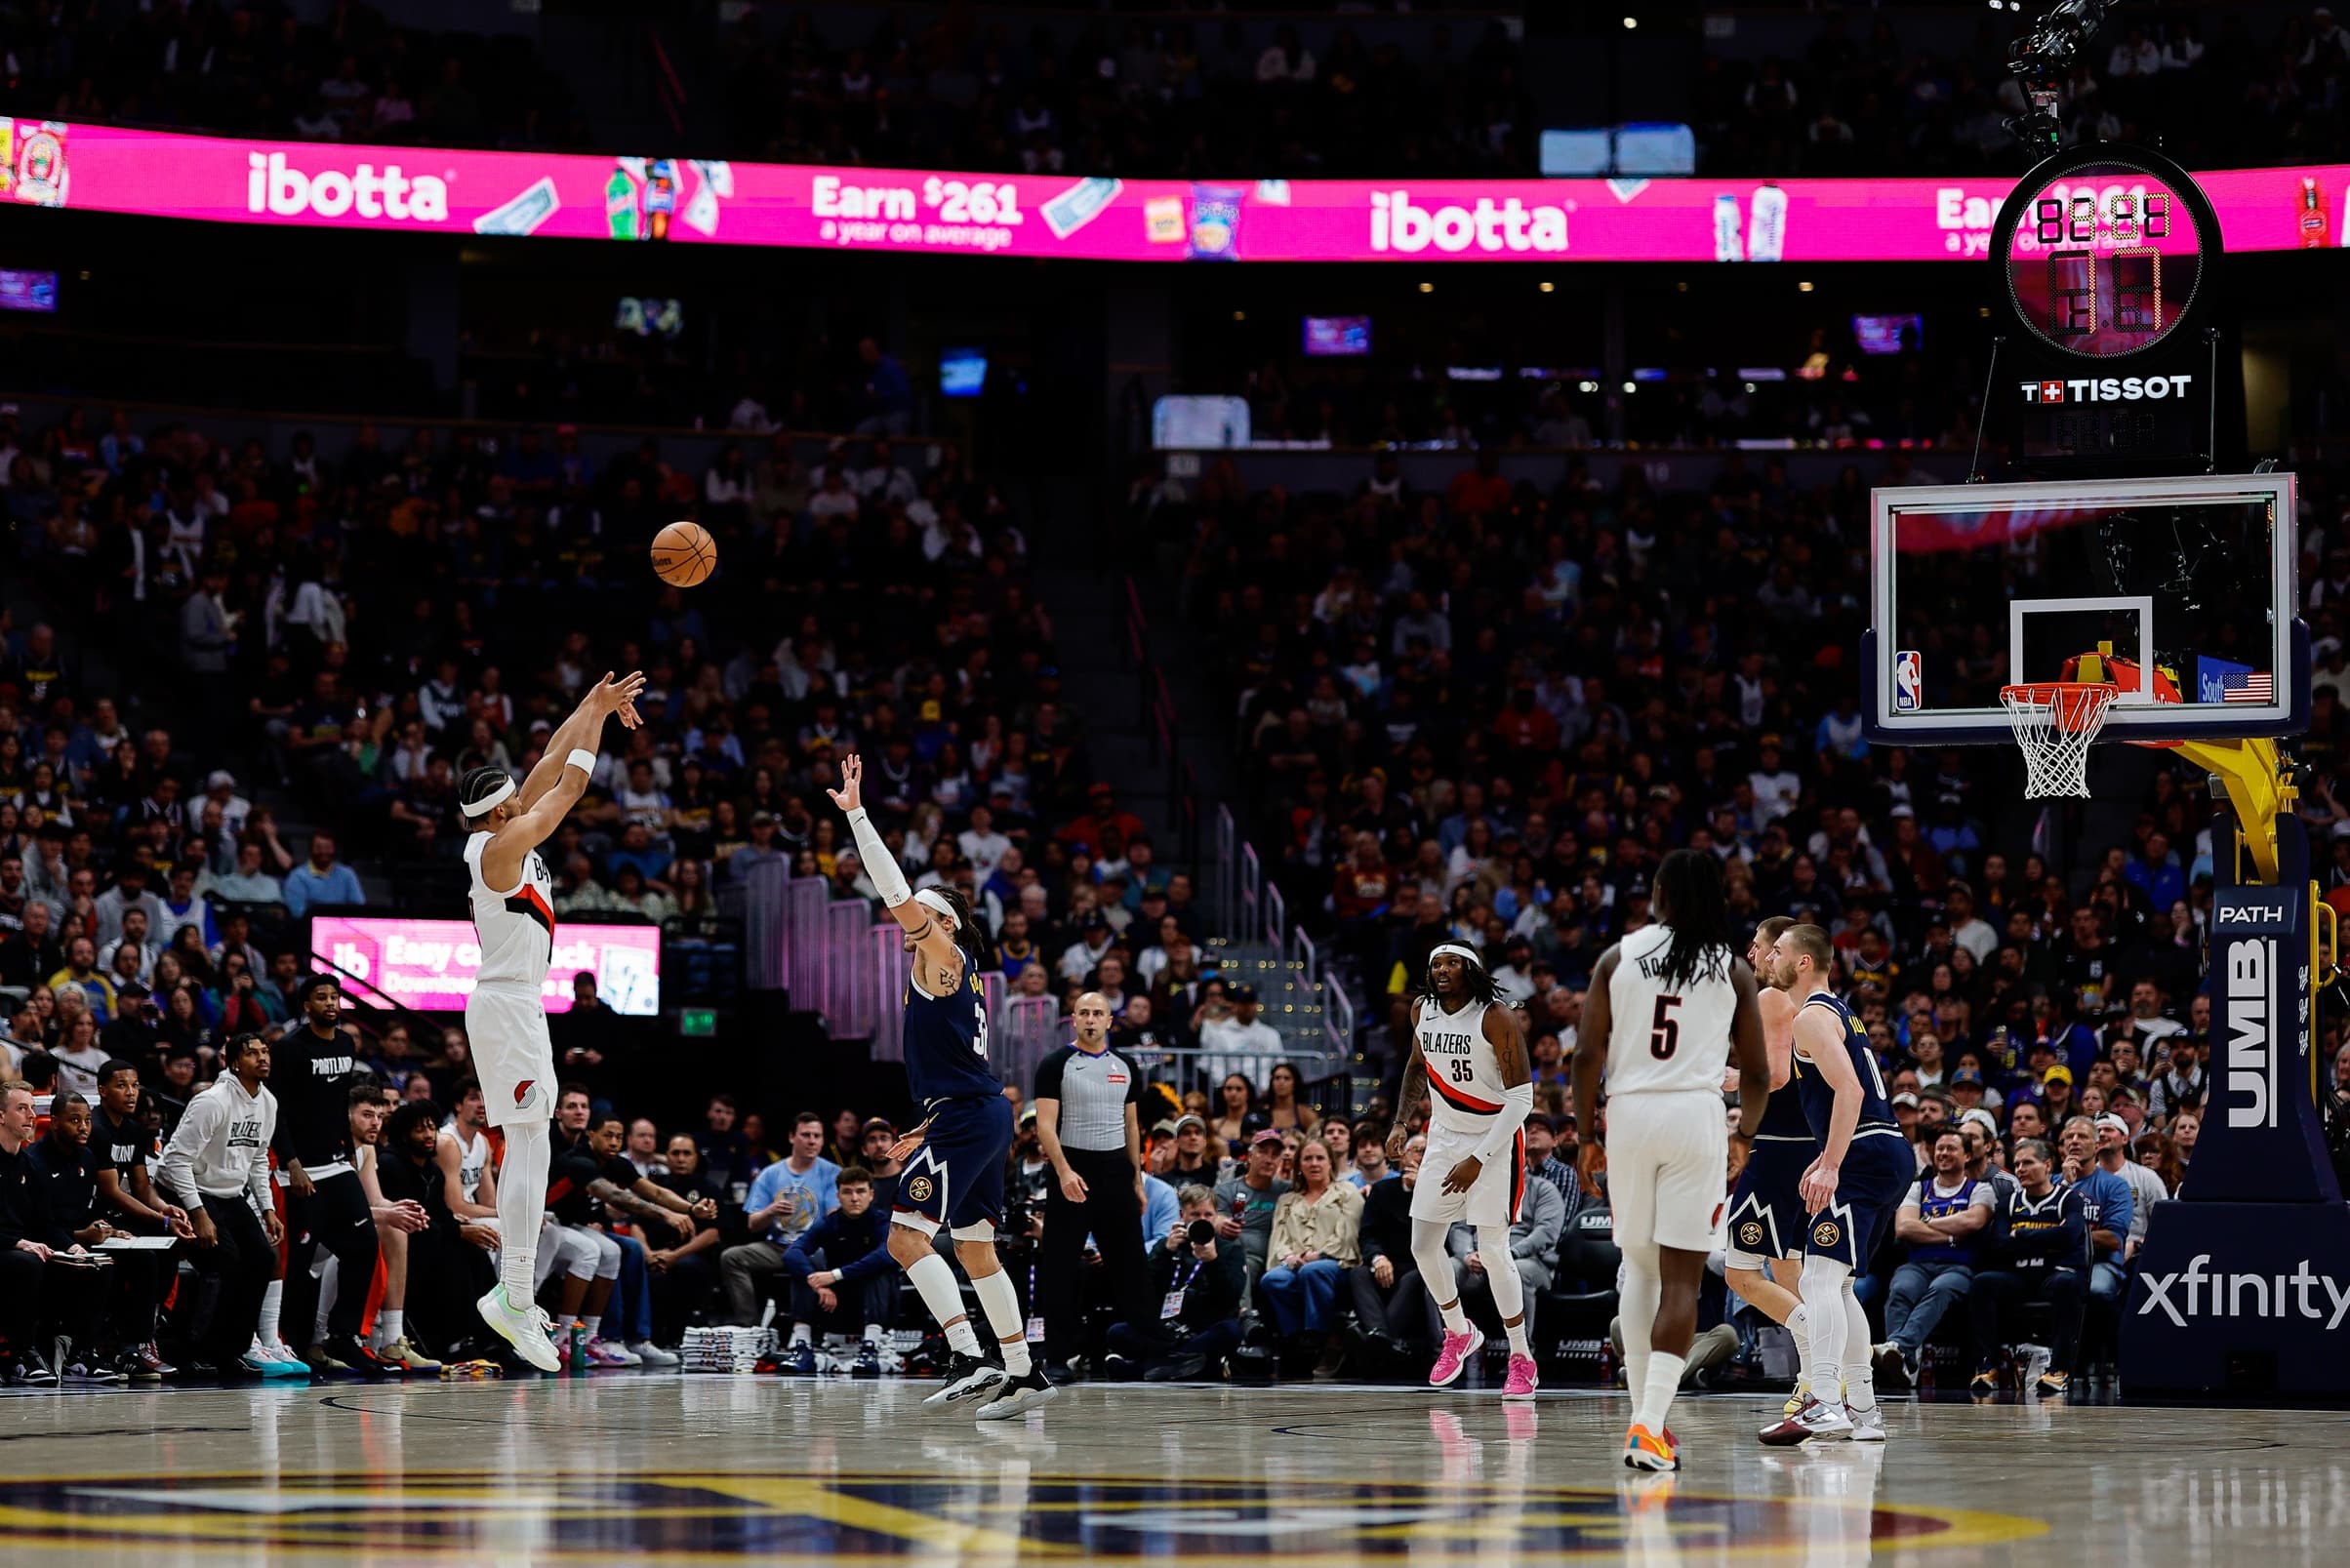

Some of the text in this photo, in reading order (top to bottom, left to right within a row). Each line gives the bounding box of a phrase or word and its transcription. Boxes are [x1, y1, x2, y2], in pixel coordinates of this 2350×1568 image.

[248, 150, 449, 222] ibotta
[812, 175, 1024, 225] Earn $261
[820, 220, 1012, 252] a year on average
[1370, 189, 1569, 253] ibotta
[2067, 375, 2192, 402] TISSOT
[1898, 696, 1913, 707] NBA
[2219, 905, 2283, 923] PATH
[385, 935, 452, 972] Easy
[1422, 1031, 1472, 1055] BLAZERS
[1650, 994, 1683, 1061] 5
[2228, 938, 2268, 1128] UMB
[1450, 1059, 1474, 1082] 35
[1580, 1216, 1612, 1228] UM
[2137, 1254, 2350, 1330] xfinity
